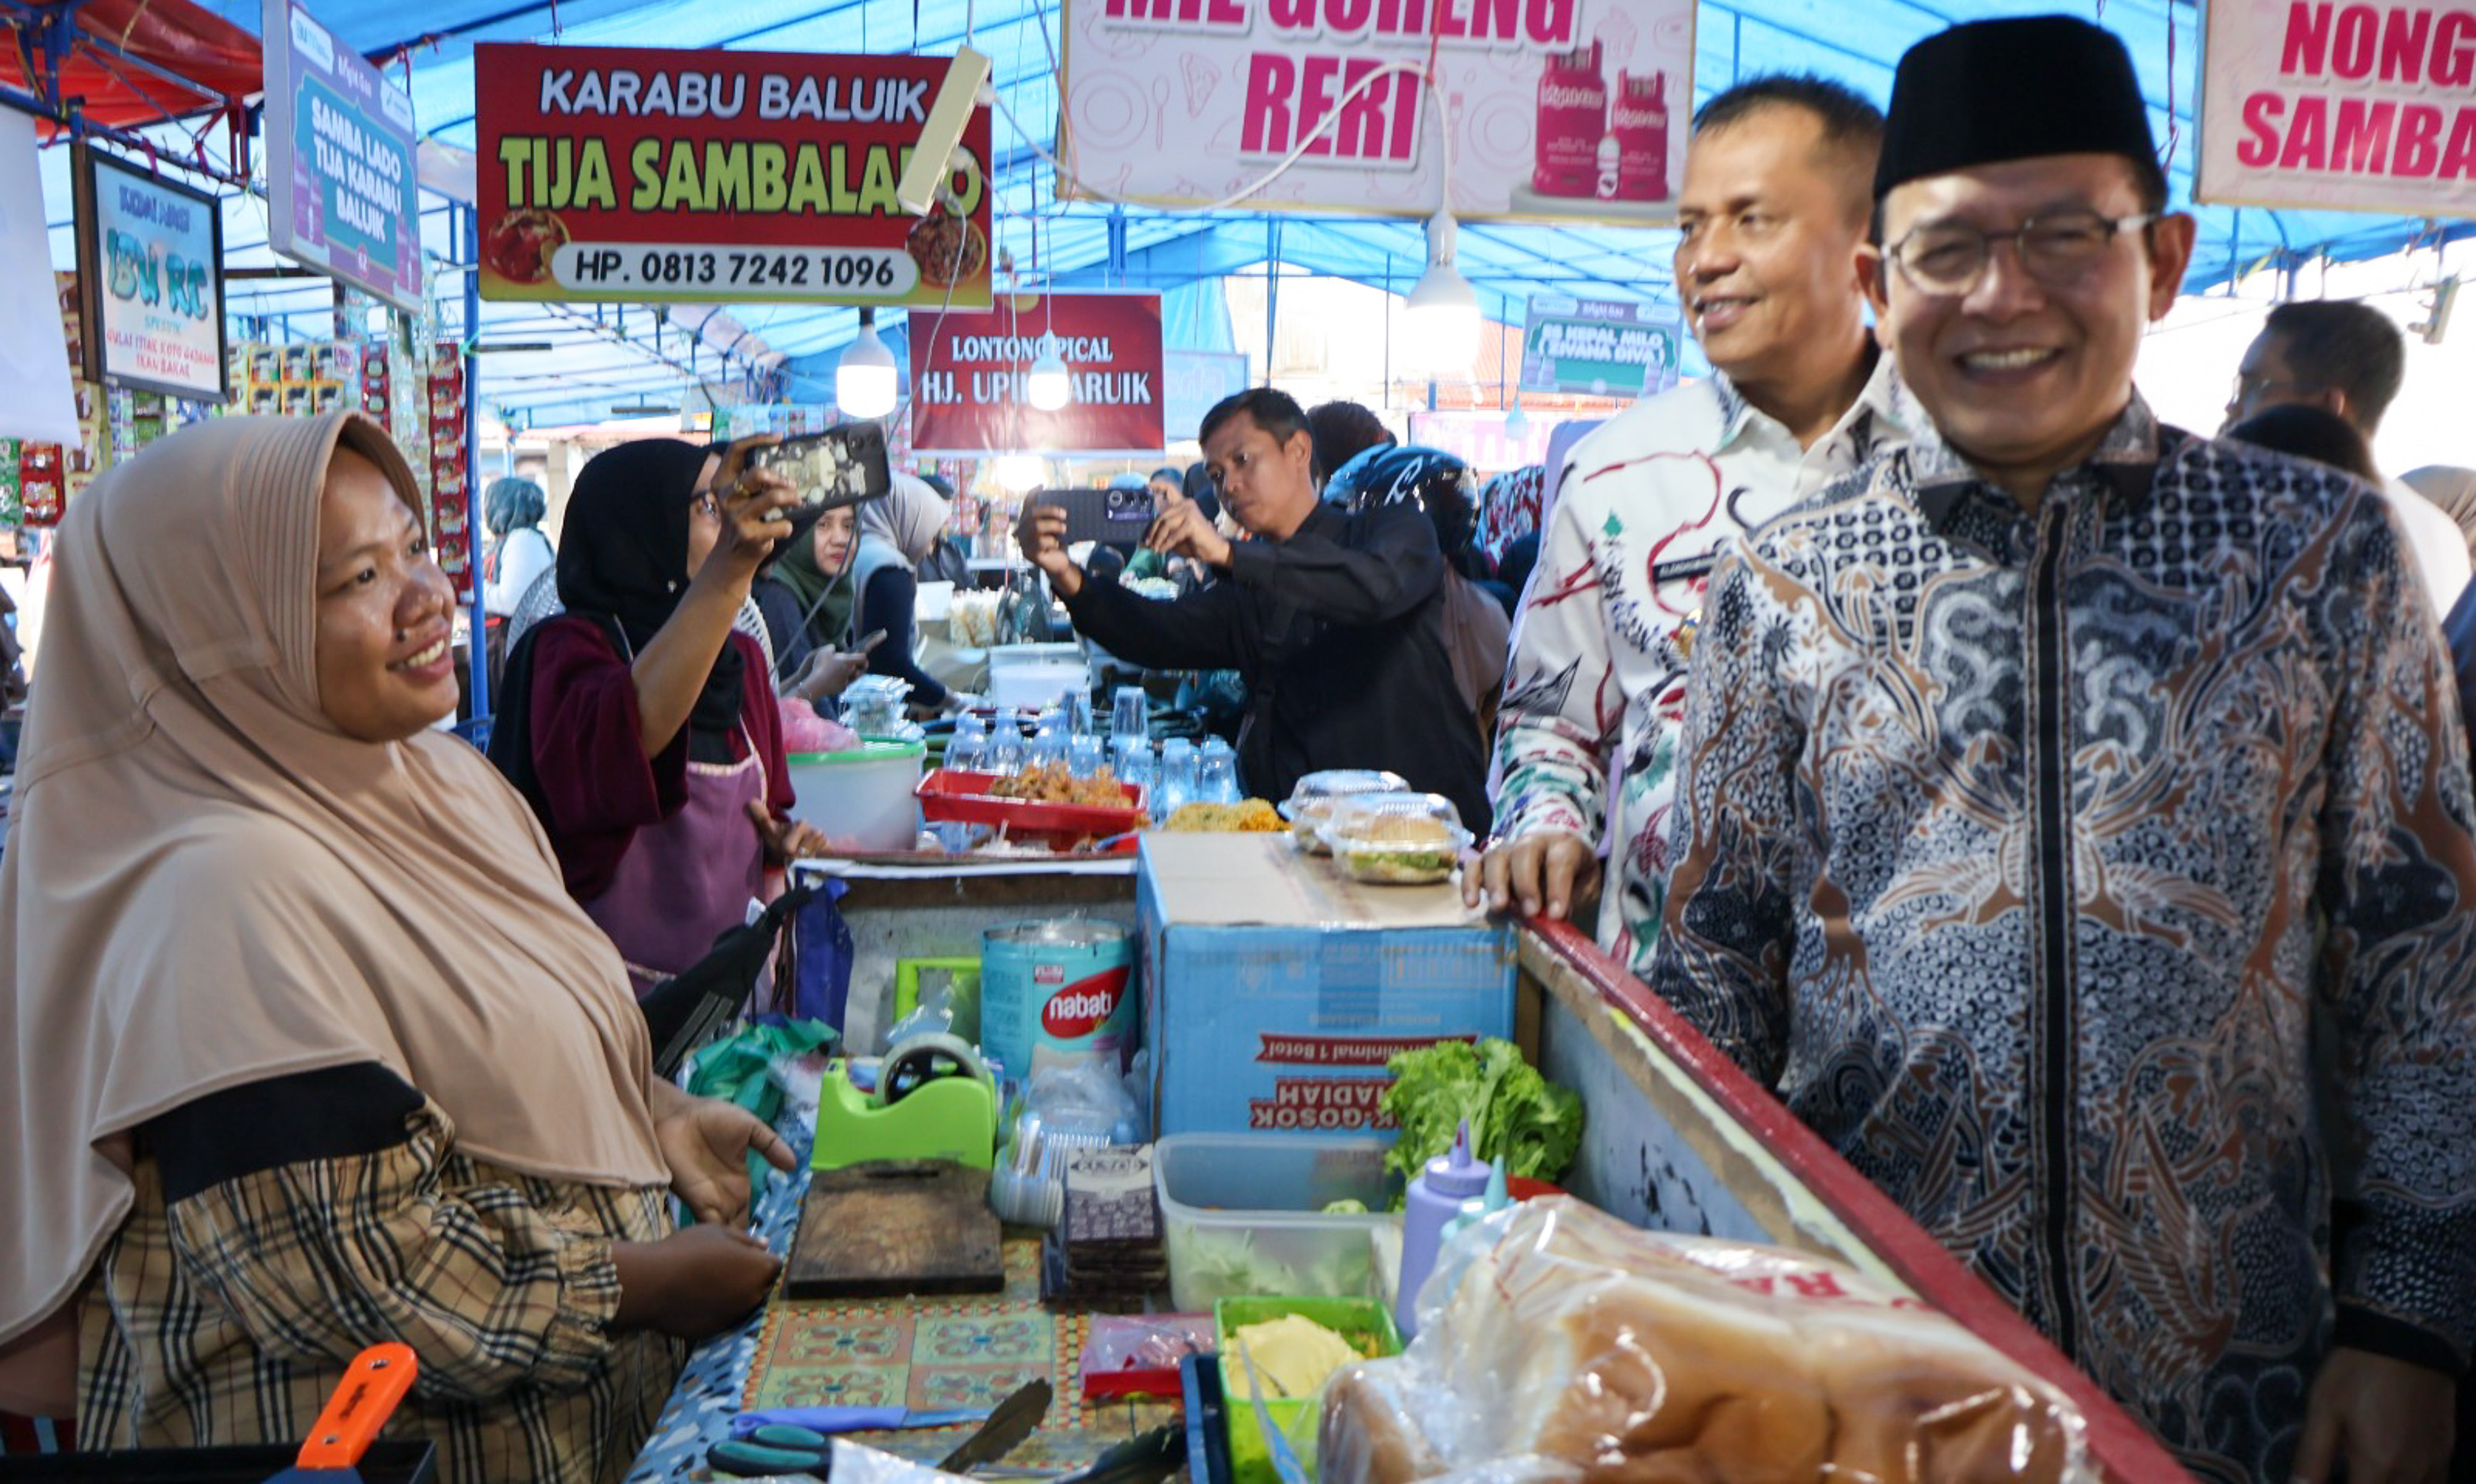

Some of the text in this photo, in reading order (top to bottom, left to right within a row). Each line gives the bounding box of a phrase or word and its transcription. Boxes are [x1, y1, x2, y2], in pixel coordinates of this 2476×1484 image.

[2280, 1, 2476, 88] NONG
[540, 68, 928, 123] KARABU BALUIK
[1240, 51, 1421, 161] RERI
[312, 96, 364, 160] SAMBA
[366, 132, 402, 184] LADO
[2236, 90, 2476, 181] SAMBA
[313, 132, 402, 217] TIJA KARABU
[498, 136, 983, 218] TIJA SAMBALAO
[336, 185, 386, 244] BALUIK
[576, 251, 894, 289] HP. 0813 7242 1096
[1057, 336, 1113, 363] PICAL
[1620, 330, 1664, 348] MILO
[921, 371, 963, 404] HJ.
[1068, 370, 1152, 404] ARUIK
[1049, 989, 1112, 1020] nabati
